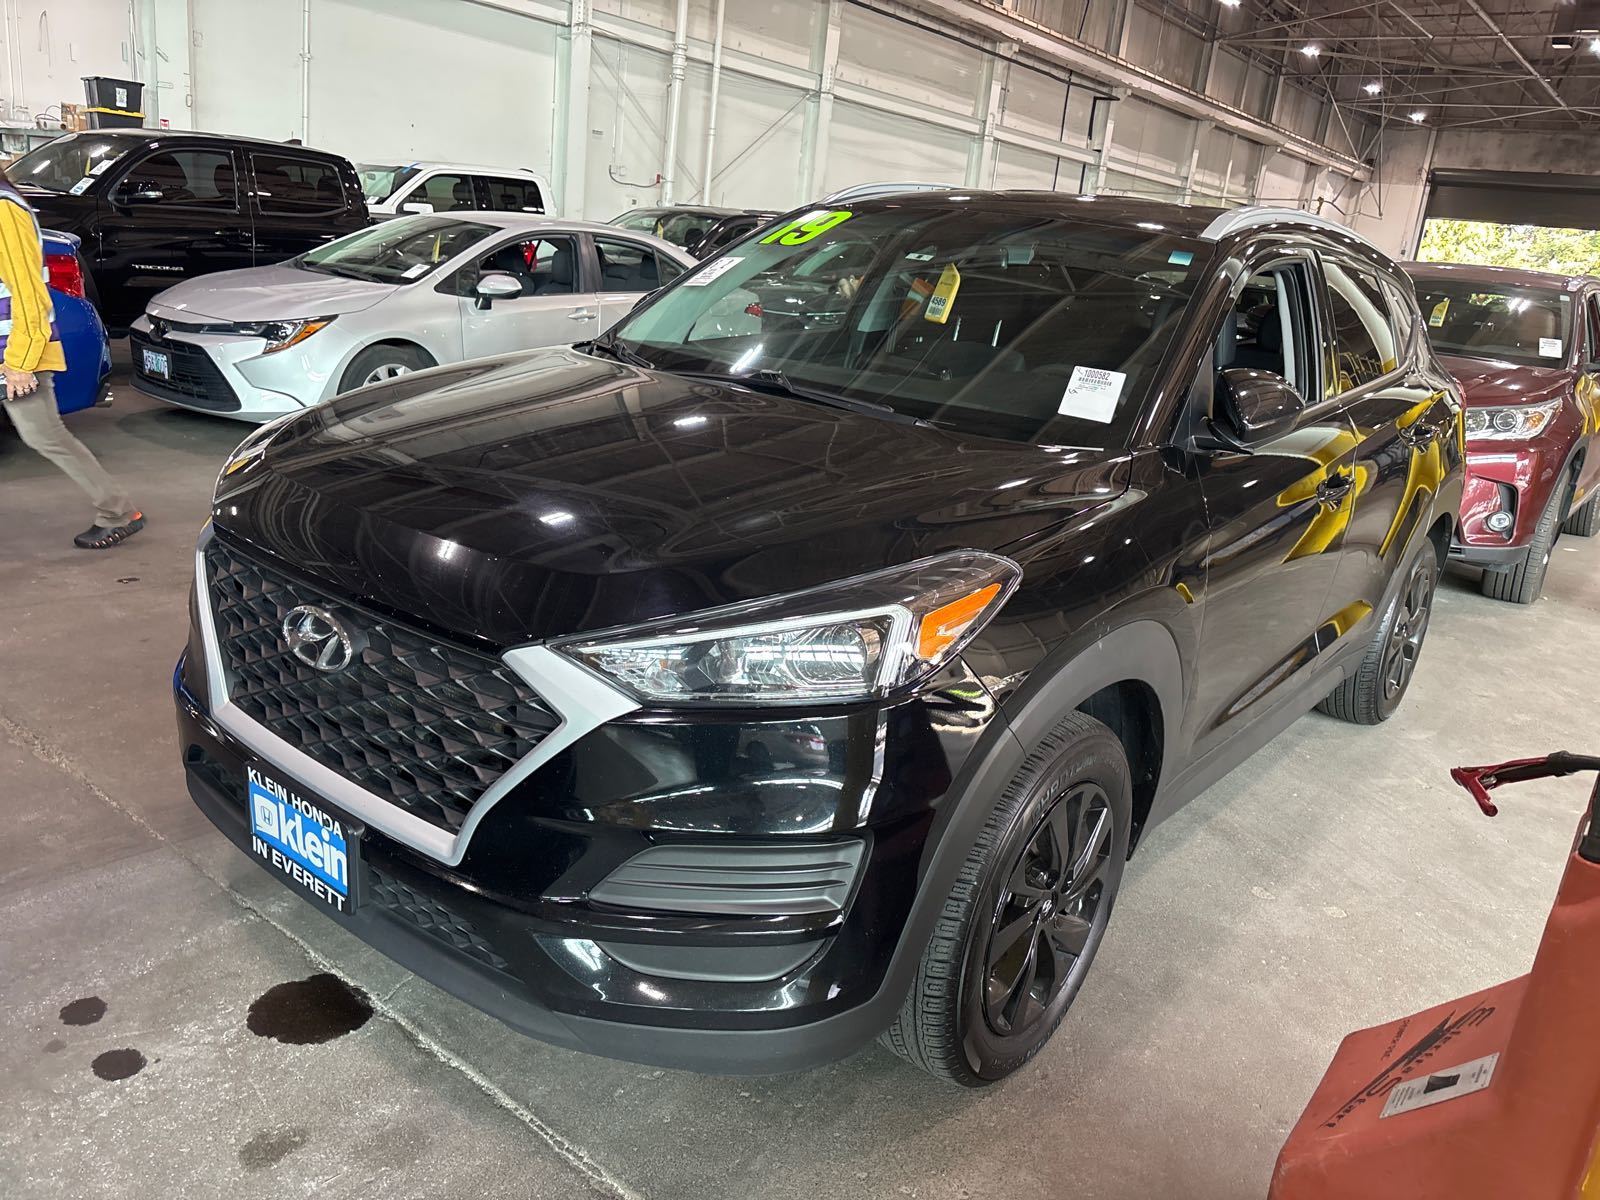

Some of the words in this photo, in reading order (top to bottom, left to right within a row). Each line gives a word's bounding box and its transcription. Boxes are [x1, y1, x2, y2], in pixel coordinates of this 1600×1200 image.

[759, 211, 853, 246] 19
[931, 296, 947, 307] 4589
[1084, 369, 1111, 381] 1000582
[247, 766, 288, 805] KLEIN
[291, 793, 344, 840] HONDA
[279, 802, 347, 887] klein
[252, 836, 268, 859] IN
[272, 848, 346, 912] EVERETT
